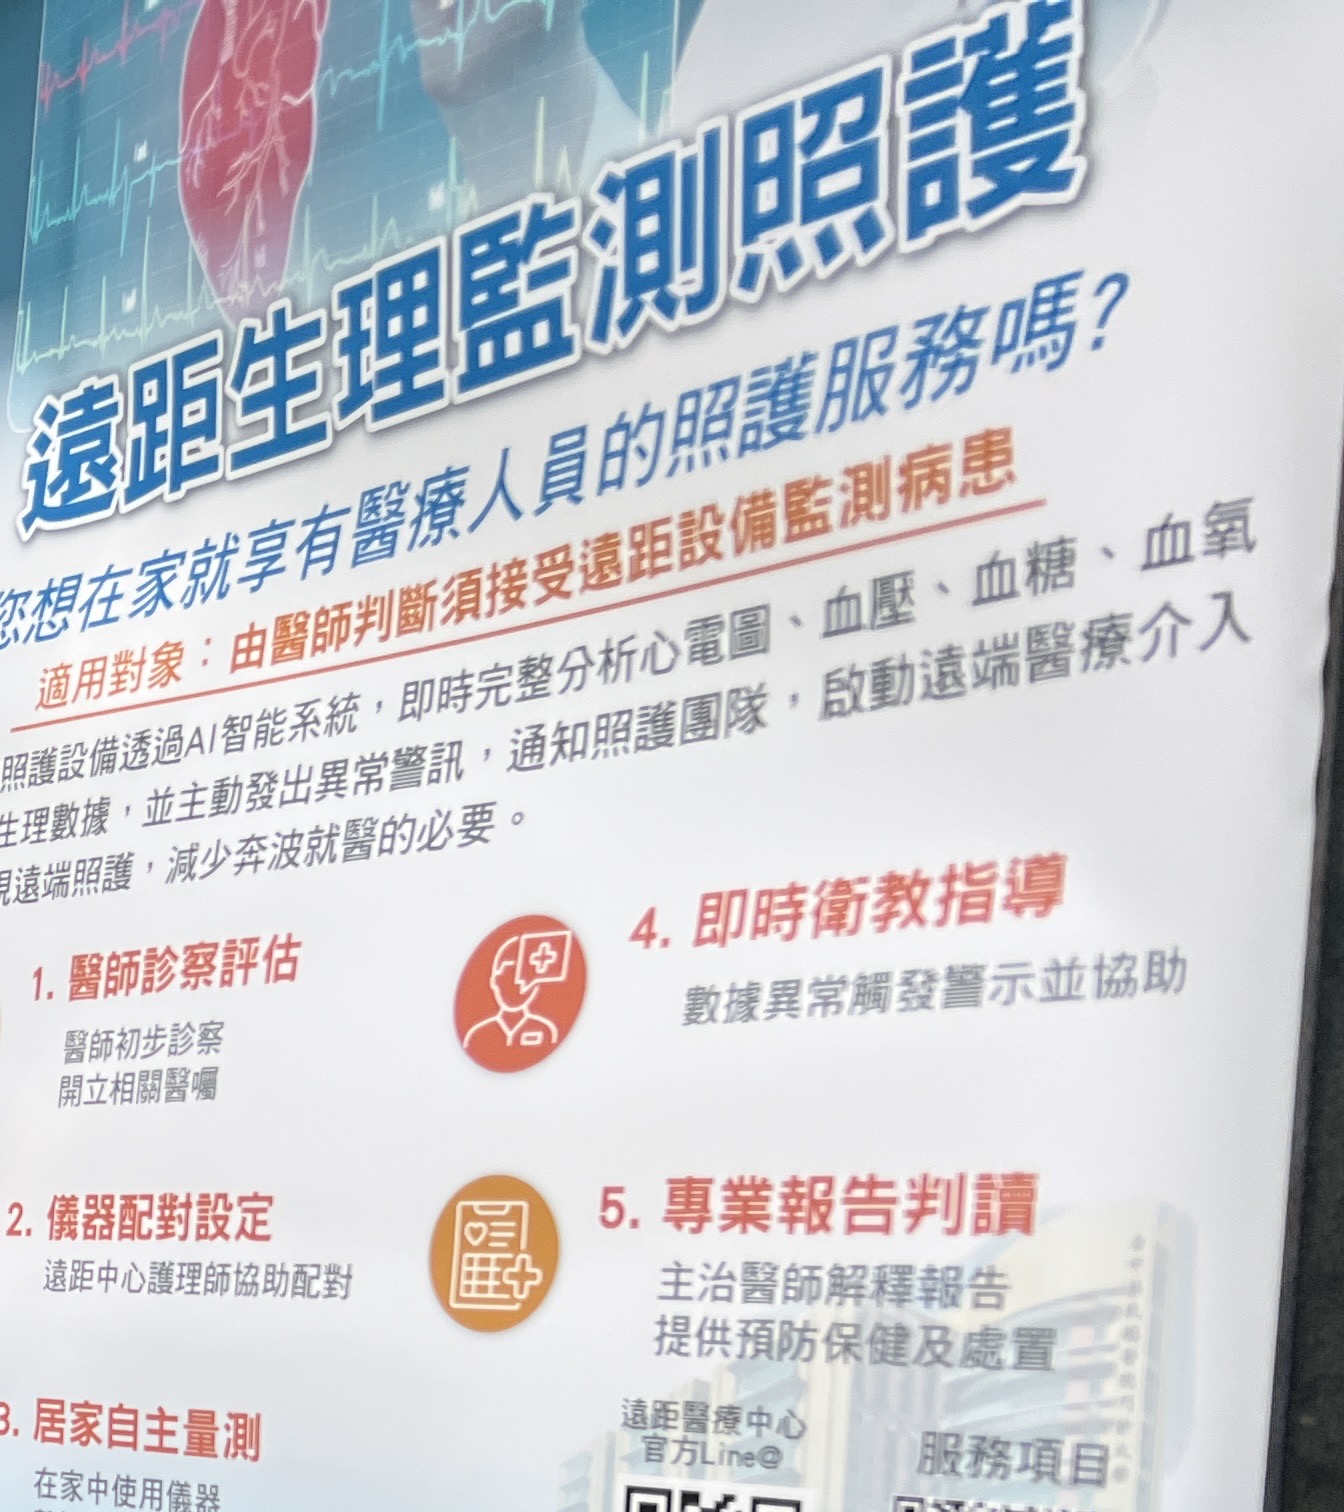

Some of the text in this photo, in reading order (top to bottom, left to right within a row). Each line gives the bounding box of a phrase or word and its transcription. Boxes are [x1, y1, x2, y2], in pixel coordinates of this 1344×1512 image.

[20, 2, 1084, 534] 遠距生理監測照護
[629, 852, 1069, 949] 4. 即時衛教指導
[32, 933, 302, 1002] 1. 醫師診察評估
[682, 946, 1188, 1027] 數據異常觸發警示並協助
[63, 1021, 225, 1065] 醫師初步診察
[58, 1067, 219, 1109] 開立相關醫囑
[7, 1192, 273, 1243] 2. 儀器配對設定
[599, 1172, 1039, 1236] 5. 專業報告判讀
[43, 1258, 353, 1300] 遠距中心護理師協助配對
[658, 1261, 1012, 1311] 主治醫師解釋報告
[654, 1314, 1057, 1372] 提供預防保健及處置
[33, 1398, 262, 1462] 居家自主量測
[622, 1398, 807, 1441] 遠距醫療中心
[641, 1432, 783, 1469] 官方Line@
[918, 1431, 1110, 1487] 服務項目
